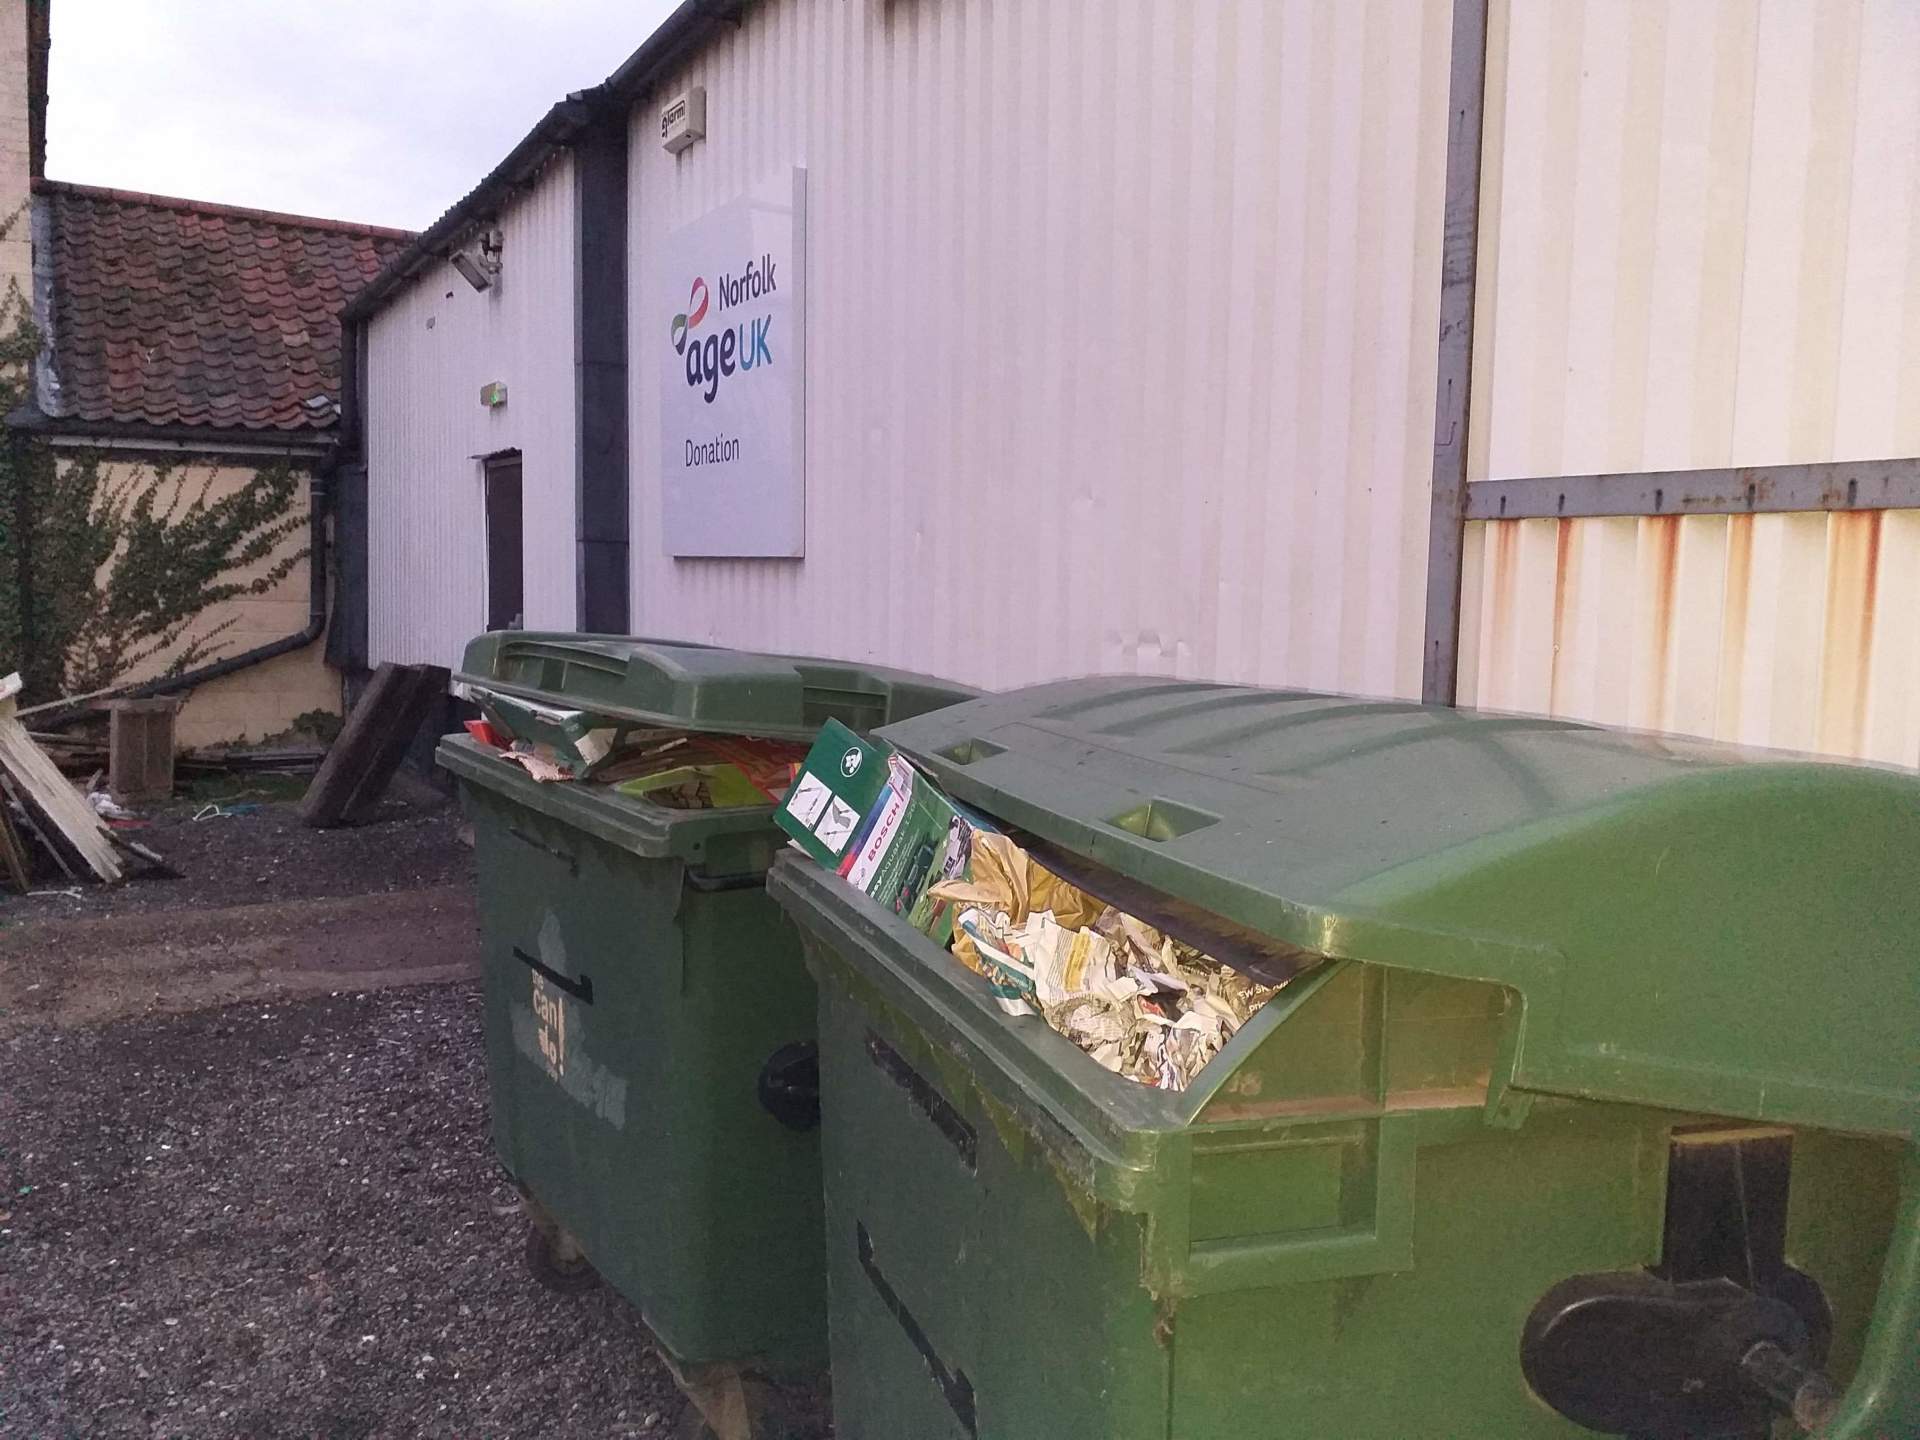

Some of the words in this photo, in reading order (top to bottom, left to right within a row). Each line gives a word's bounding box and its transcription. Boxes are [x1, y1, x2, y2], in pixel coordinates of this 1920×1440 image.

[719, 253, 777, 311] Norfolk
[685, 433, 740, 467] Donation
[867, 803, 900, 861] BOSCH
